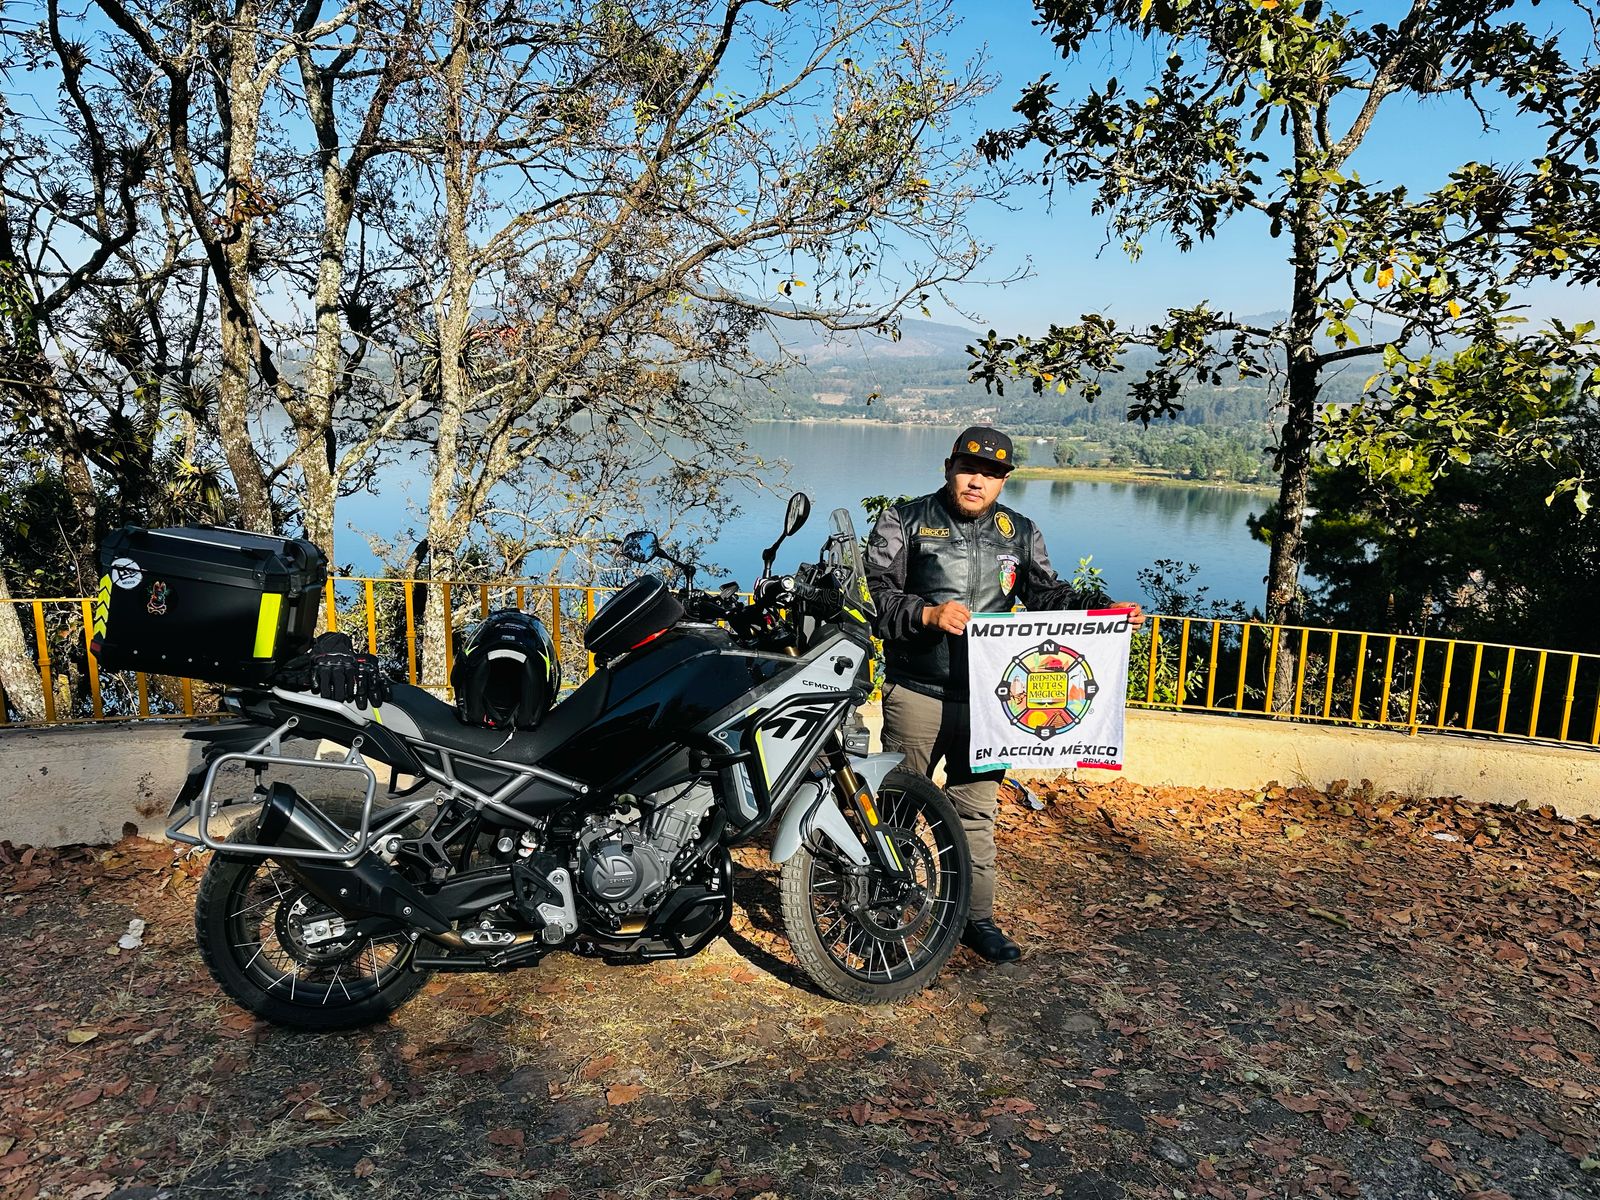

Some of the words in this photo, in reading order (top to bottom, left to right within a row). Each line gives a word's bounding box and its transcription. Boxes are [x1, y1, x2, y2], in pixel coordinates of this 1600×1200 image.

[971, 621, 1129, 637] MOTOTURISMO
[1043, 643, 1055, 652] N
[802, 680, 841, 692] CFMOTO
[1087, 686, 1096, 694] E
[998, 687, 1008, 696] O
[1040, 729, 1051, 737] S
[975, 747, 993, 760] EN
[998, 742, 1055, 757] ACCIÓN
[1060, 741, 1118, 757] MÉXICO
